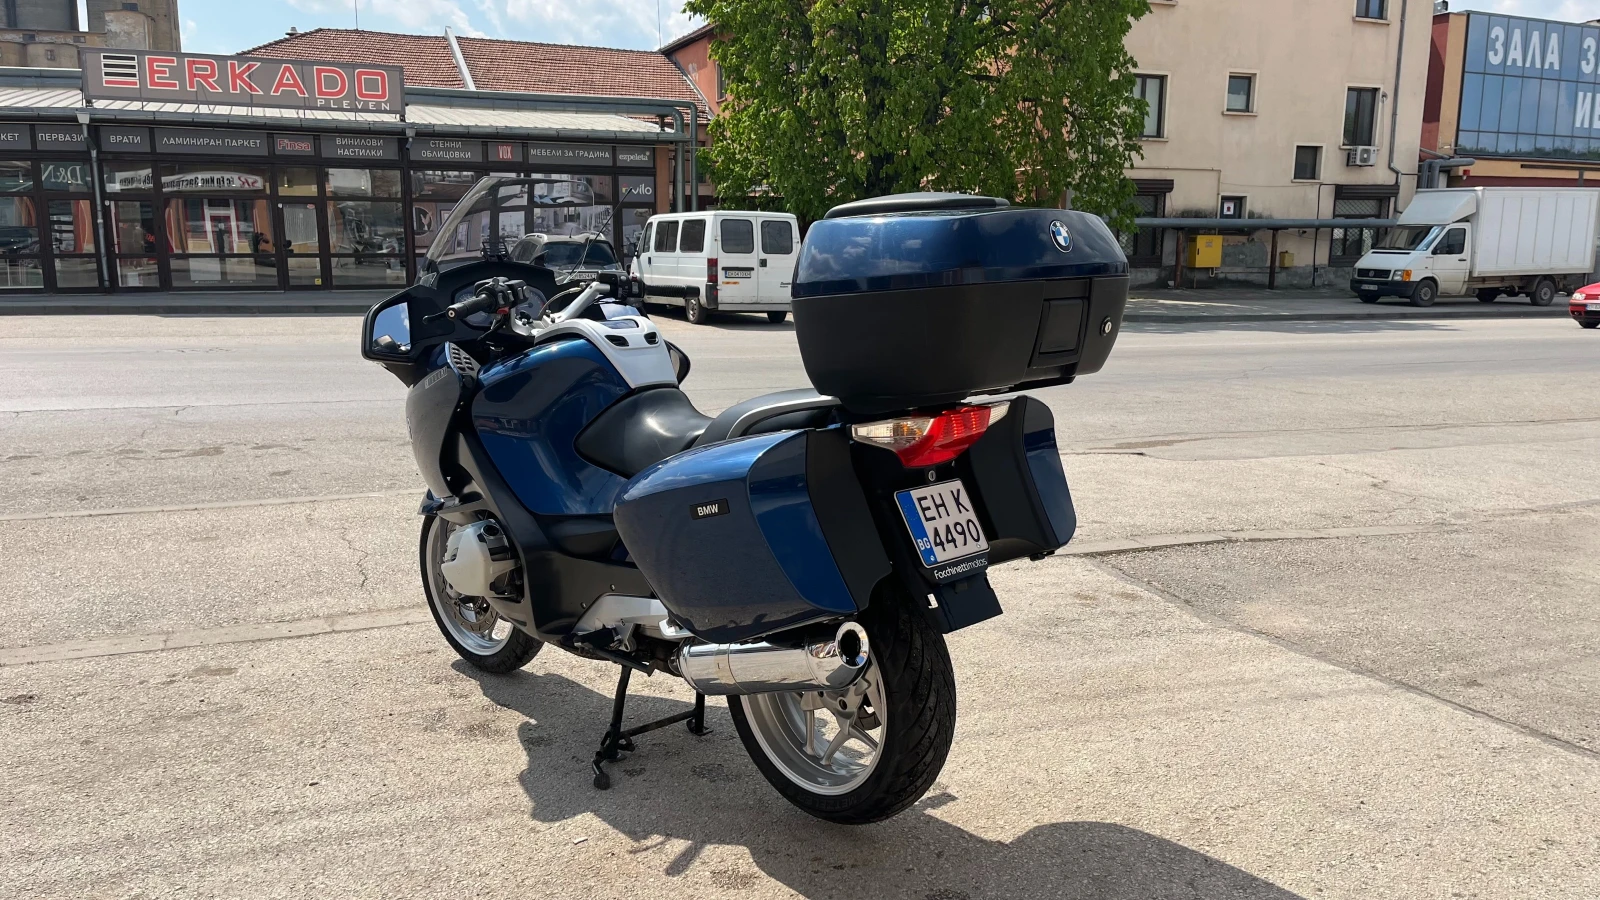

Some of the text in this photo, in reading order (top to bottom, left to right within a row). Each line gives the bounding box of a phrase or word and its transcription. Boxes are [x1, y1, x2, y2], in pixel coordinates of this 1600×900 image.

[1488, 26, 1600, 75] ЗАЛА З
[145, 55, 389, 101] ERKADO
[317, 99, 390, 110] PLEVEN
[38, 133, 85, 142] ПЕРВАЗИ
[110, 135, 141, 144] ВРАТИ
[162, 137, 261, 148] ЛАМИНИРАН ПАРКЕТ
[336, 137, 384, 147] ВИНИЛОВИ
[277, 138, 312, 151] Finsa
[430, 140, 462, 149] СТЕННИ
[337, 148, 383, 157] НАСТИЛКИ
[421, 150, 471, 159] ОБЛИЦОВКИ
[498, 145, 512, 159] VOX
[530, 148, 562, 157] МЕБЕЛИ
[575, 151, 610, 159] ГРАДИНА
[631, 183, 652, 195] vilo
[697, 503, 718, 516] BMW
[916, 488, 970, 523] EH K
[933, 519, 981, 552] 4490
[917, 538, 931, 551] BG
